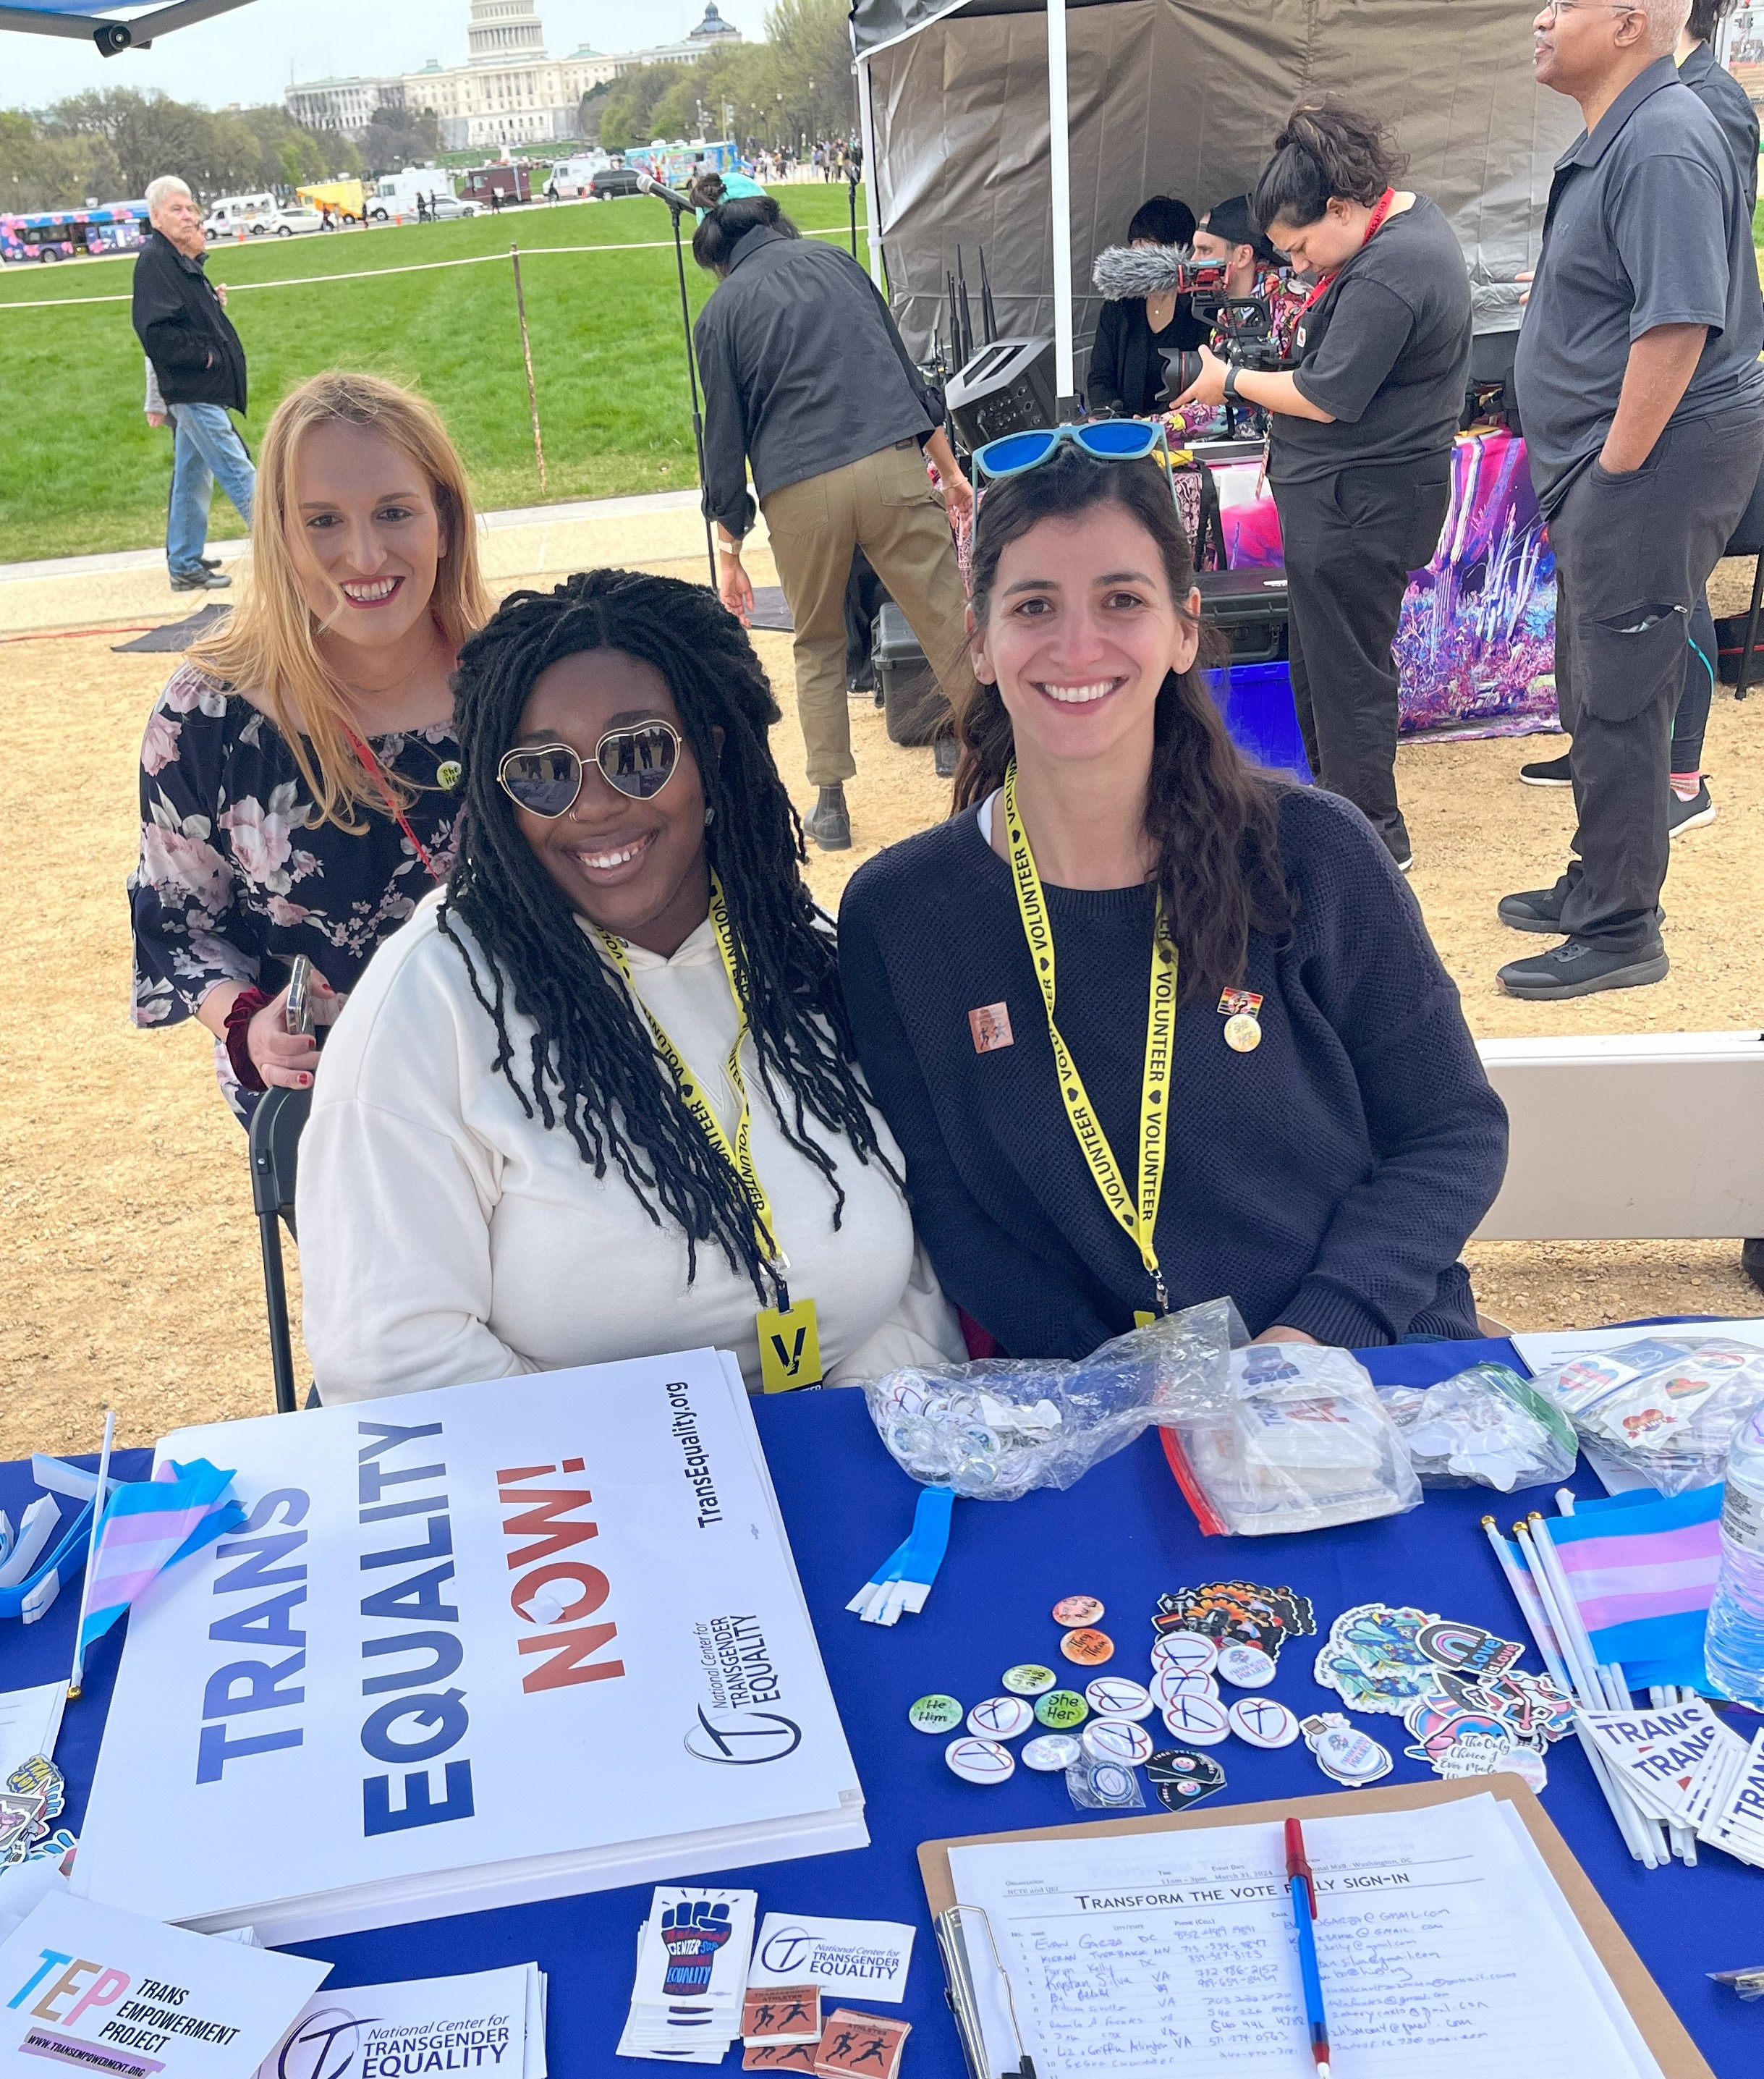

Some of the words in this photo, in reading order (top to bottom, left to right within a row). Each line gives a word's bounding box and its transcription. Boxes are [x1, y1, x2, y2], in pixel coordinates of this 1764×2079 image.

[1013, 847, 1048, 951] VOLUNTEER
[1142, 972, 1172, 1083] VOLUNTEER
[1073, 1107, 1125, 1209] VOLUNTEER
[1142, 1112, 1161, 1221] VOLUNTEER
[665, 1381, 723, 1529] TransEquality.org
[496, 1456, 626, 1695] NOW!
[196, 1486, 311, 1785] TRANS
[357, 1420, 475, 1837] EQUALITY
[693, 1622, 708, 1635] for
[700, 1635, 716, 1667] Center
[711, 1616, 751, 1708] TRANSGENDER
[730, 1615, 781, 1703] EQUALITY
[703, 1667, 728, 1708] National
[927, 1700, 946, 1709] He
[1048, 1694, 1079, 1707] She
[919, 1711, 948, 1722] Him
[1047, 1709, 1076, 1721] Her
[1595, 1708, 1705, 1745] TRANS
[1464, 1736, 1482, 1747] The
[1074, 1893, 1184, 1910] TRANSFORM
[1189, 1890, 1225, 1902] THE
[1230, 1885, 1278, 1899] VOTE
[1344, 1873, 1410, 1888] SIGN-IN
[813, 1951, 900, 1968] TRANSGENDER
[815, 1943, 856, 1954] National
[857, 1946, 885, 1956] Center
[7, 1948, 131, 2027] TEP
[810, 1962, 898, 1980] EQUALITY
[136, 1978, 190, 2006] TRANS
[98, 2020, 171, 2054] PROJECT
[116, 2000, 241, 2046] EMPOWERMENT
[367, 2022, 435, 2041] National
[436, 2015, 485, 2033] Center
[487, 2013, 509, 2027] for
[27, 2034, 145, 2078] WWW.TRANSEMPOWERMENT.ORG
[362, 2042, 509, 2078] EQUALITY
[363, 2027, 509, 2057] TRANSGENDER
